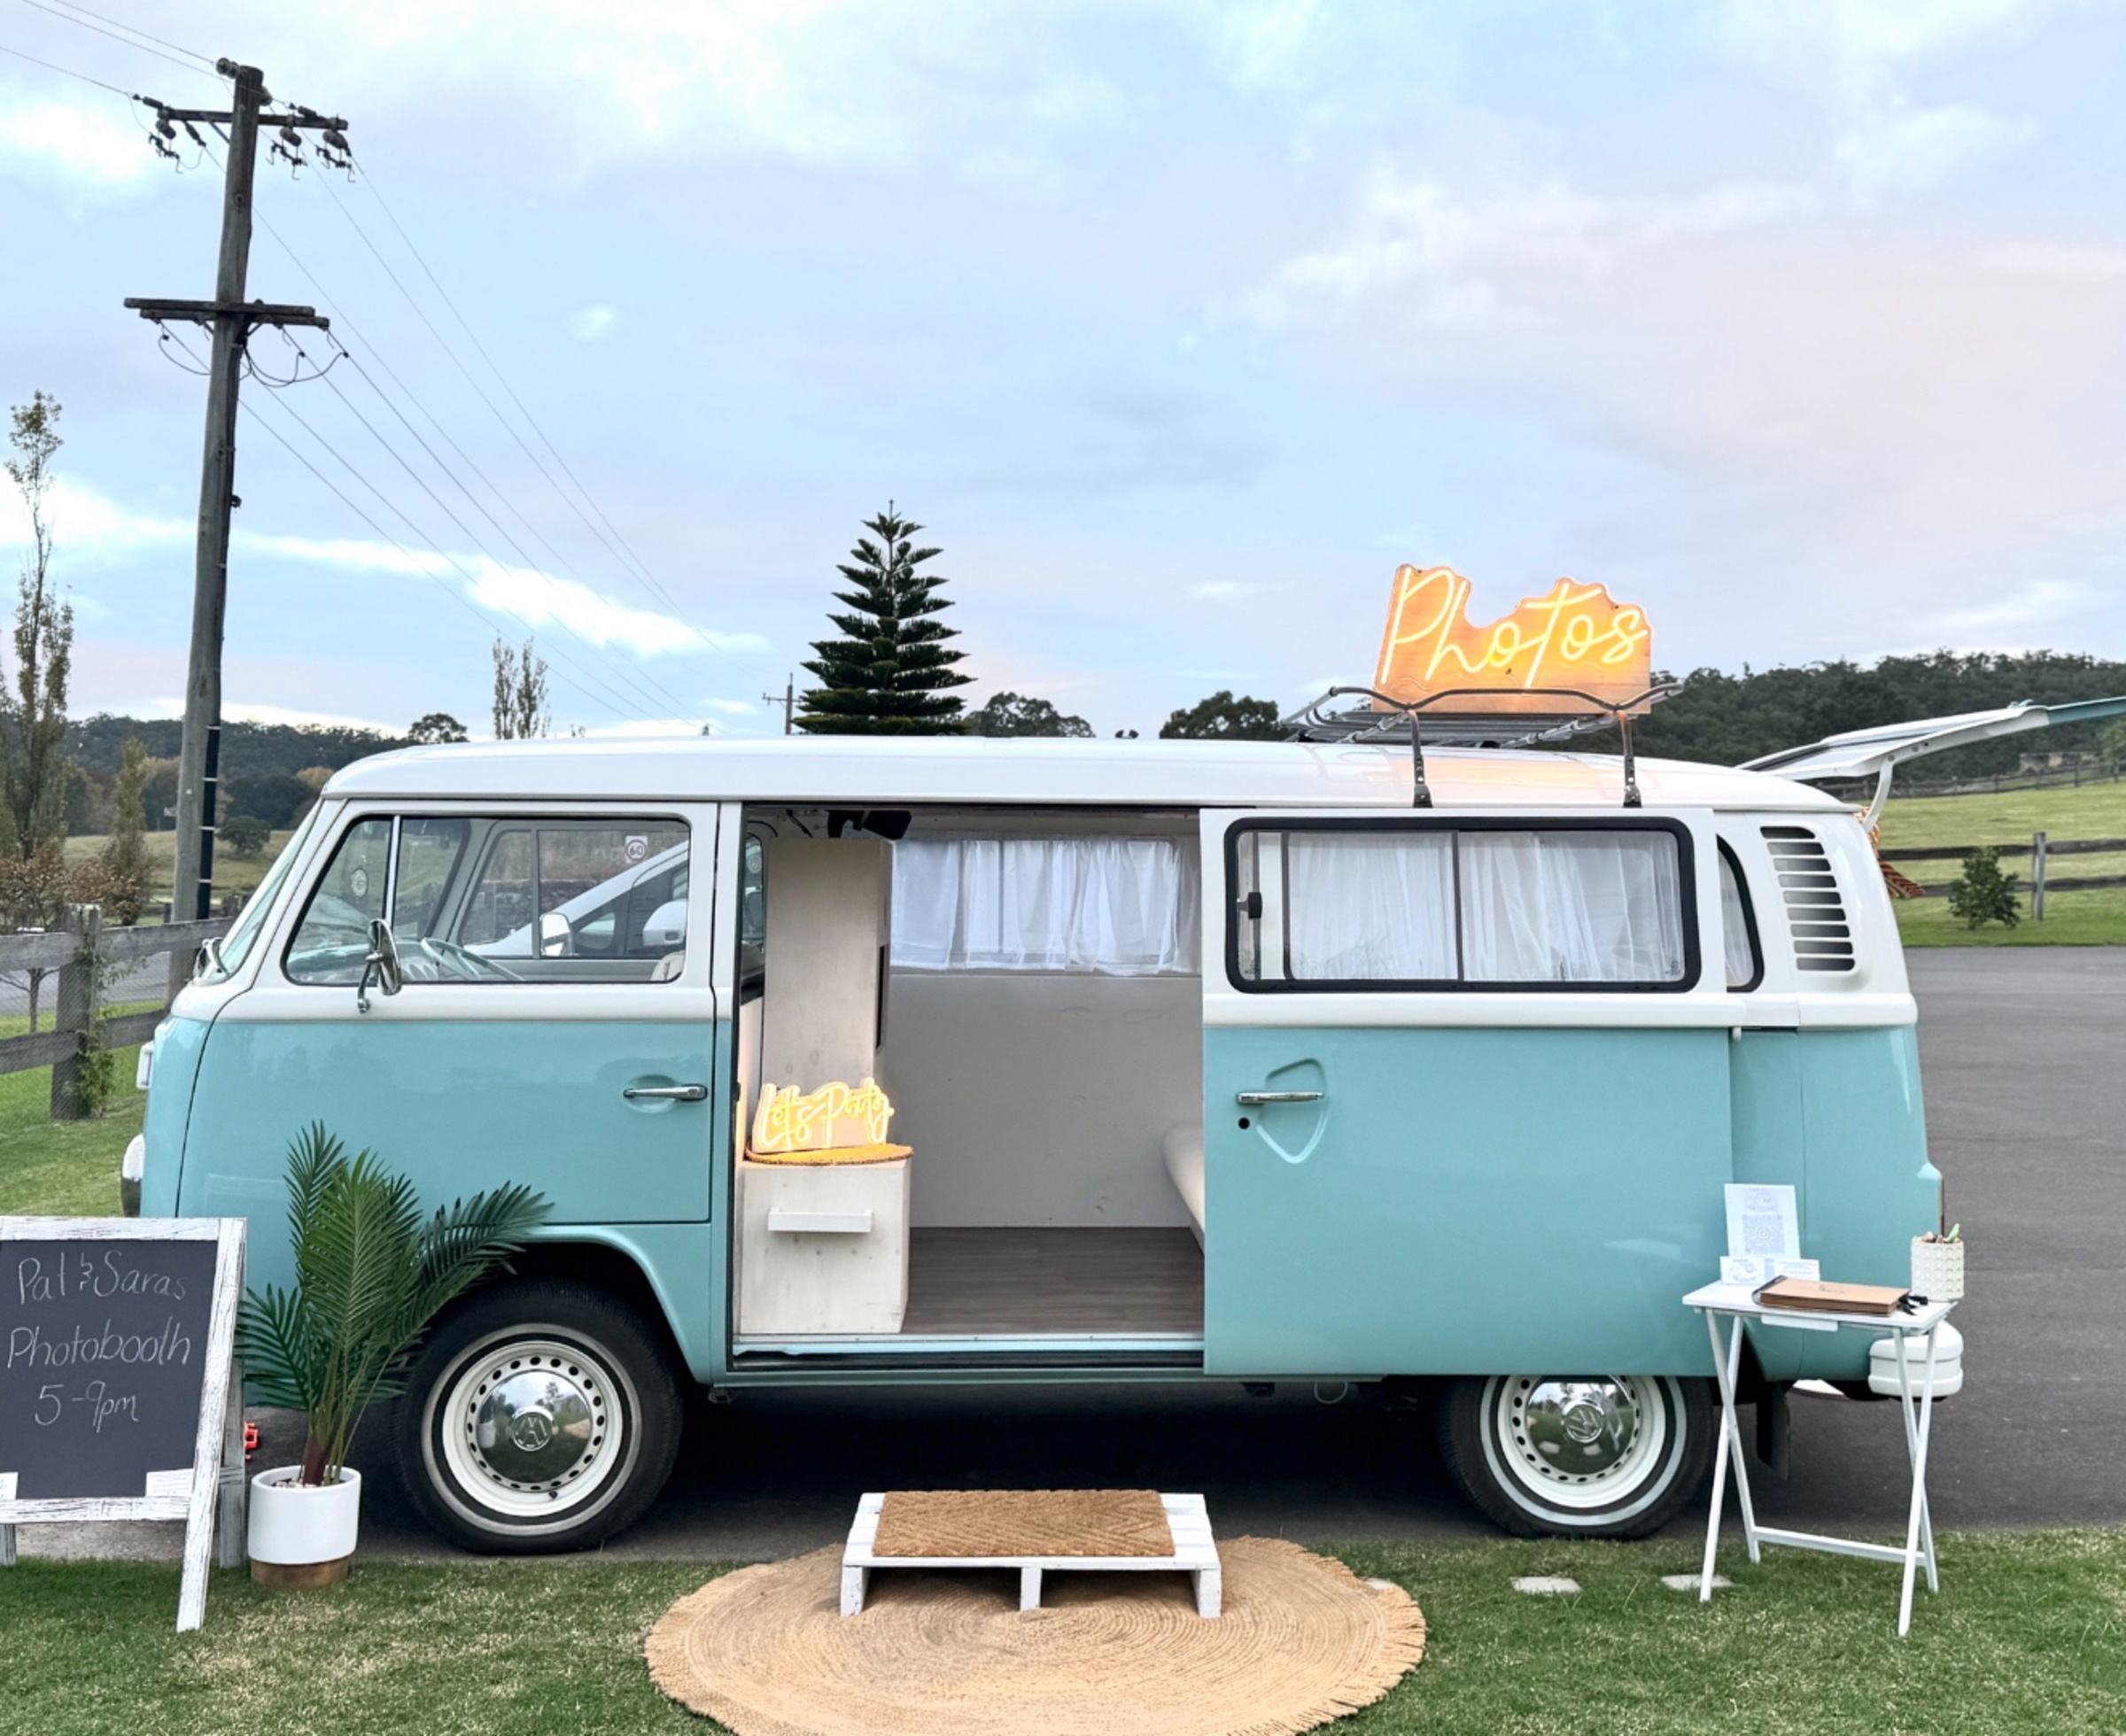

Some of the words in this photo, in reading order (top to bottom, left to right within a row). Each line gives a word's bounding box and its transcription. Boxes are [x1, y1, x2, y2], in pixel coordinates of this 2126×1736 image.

[1379, 565, 1649, 689] Photos
[629, 844, 644, 856] 60
[814, 1076, 895, 1147] Party
[93, 1249, 190, 1300] Saras
[7, 1315, 191, 1368] Photobooth
